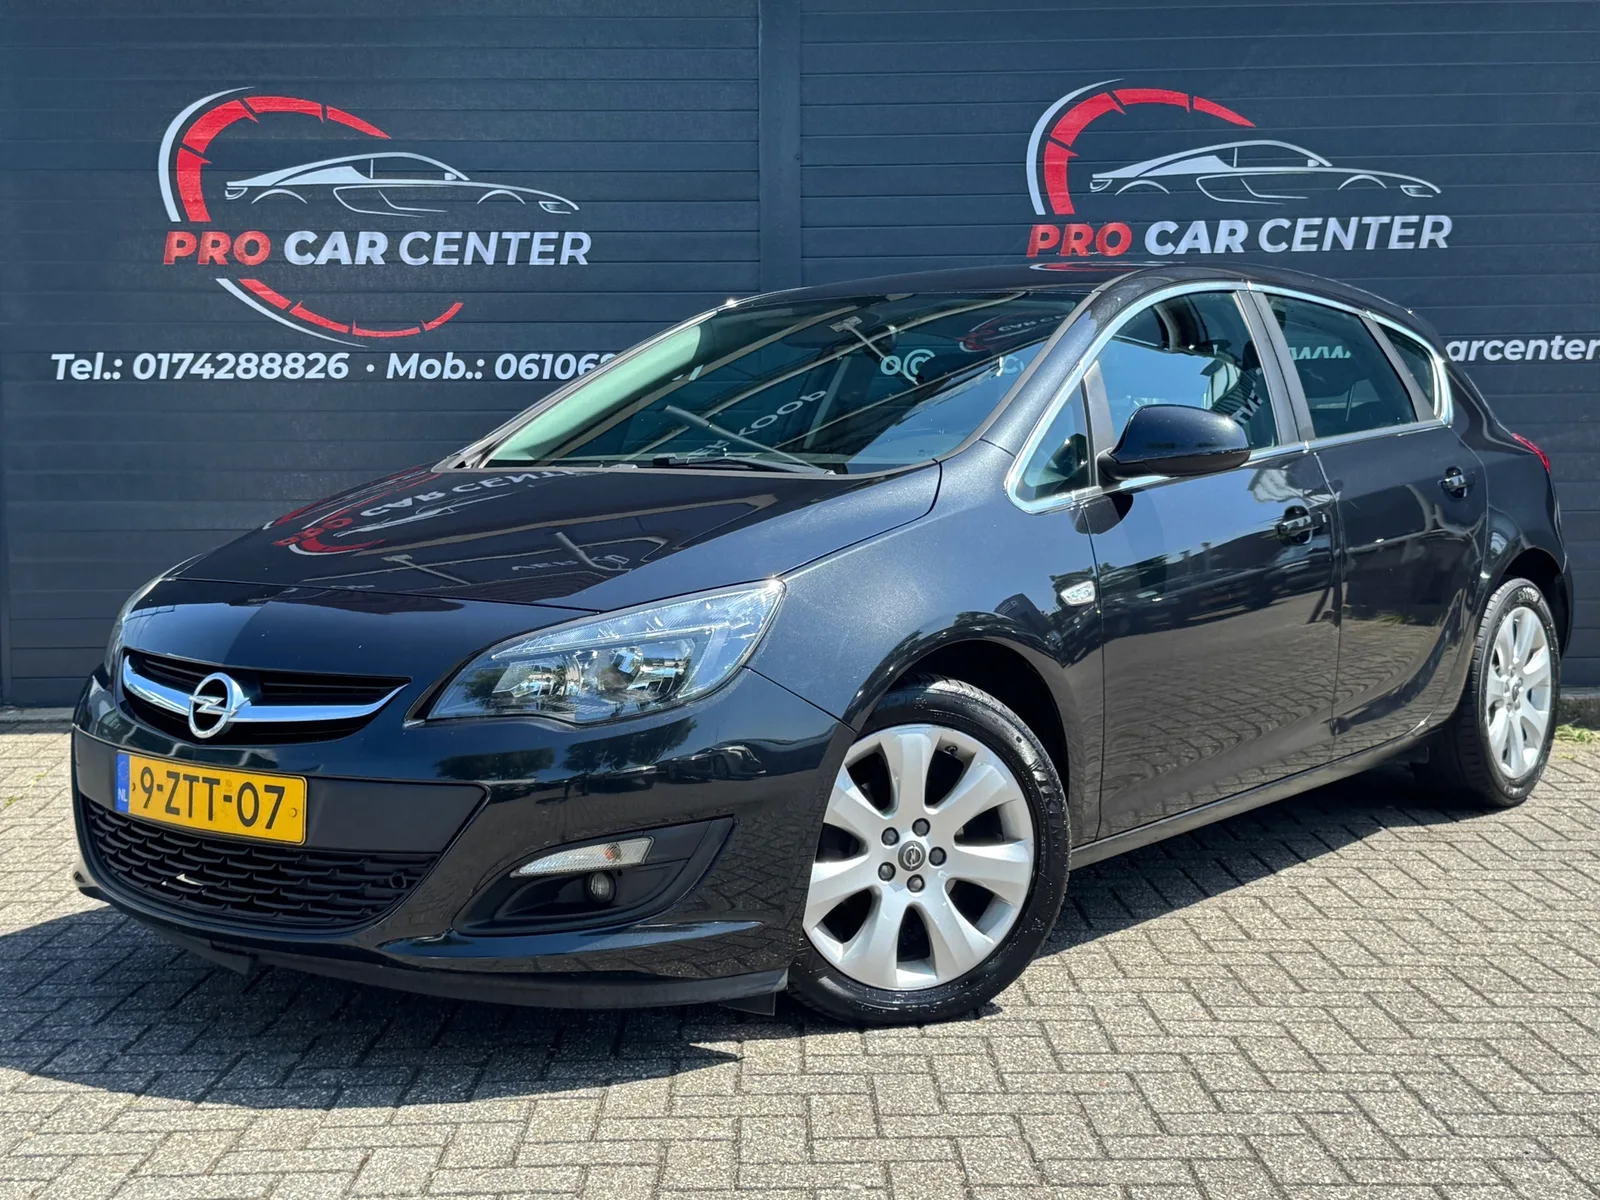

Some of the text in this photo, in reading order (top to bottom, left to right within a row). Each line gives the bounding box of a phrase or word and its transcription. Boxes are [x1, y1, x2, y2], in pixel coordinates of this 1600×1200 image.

[163, 230, 592, 266] PRO CAR CENTER
[1027, 215, 1453, 258] PRO CAR CENTER
[51, 352, 122, 380] Tel.:
[133, 352, 350, 380] 0174288826
[387, 352, 485, 380] Mob.:
[117, 788, 128, 803] NL
[140, 766, 286, 830] 9-ZTT-07
